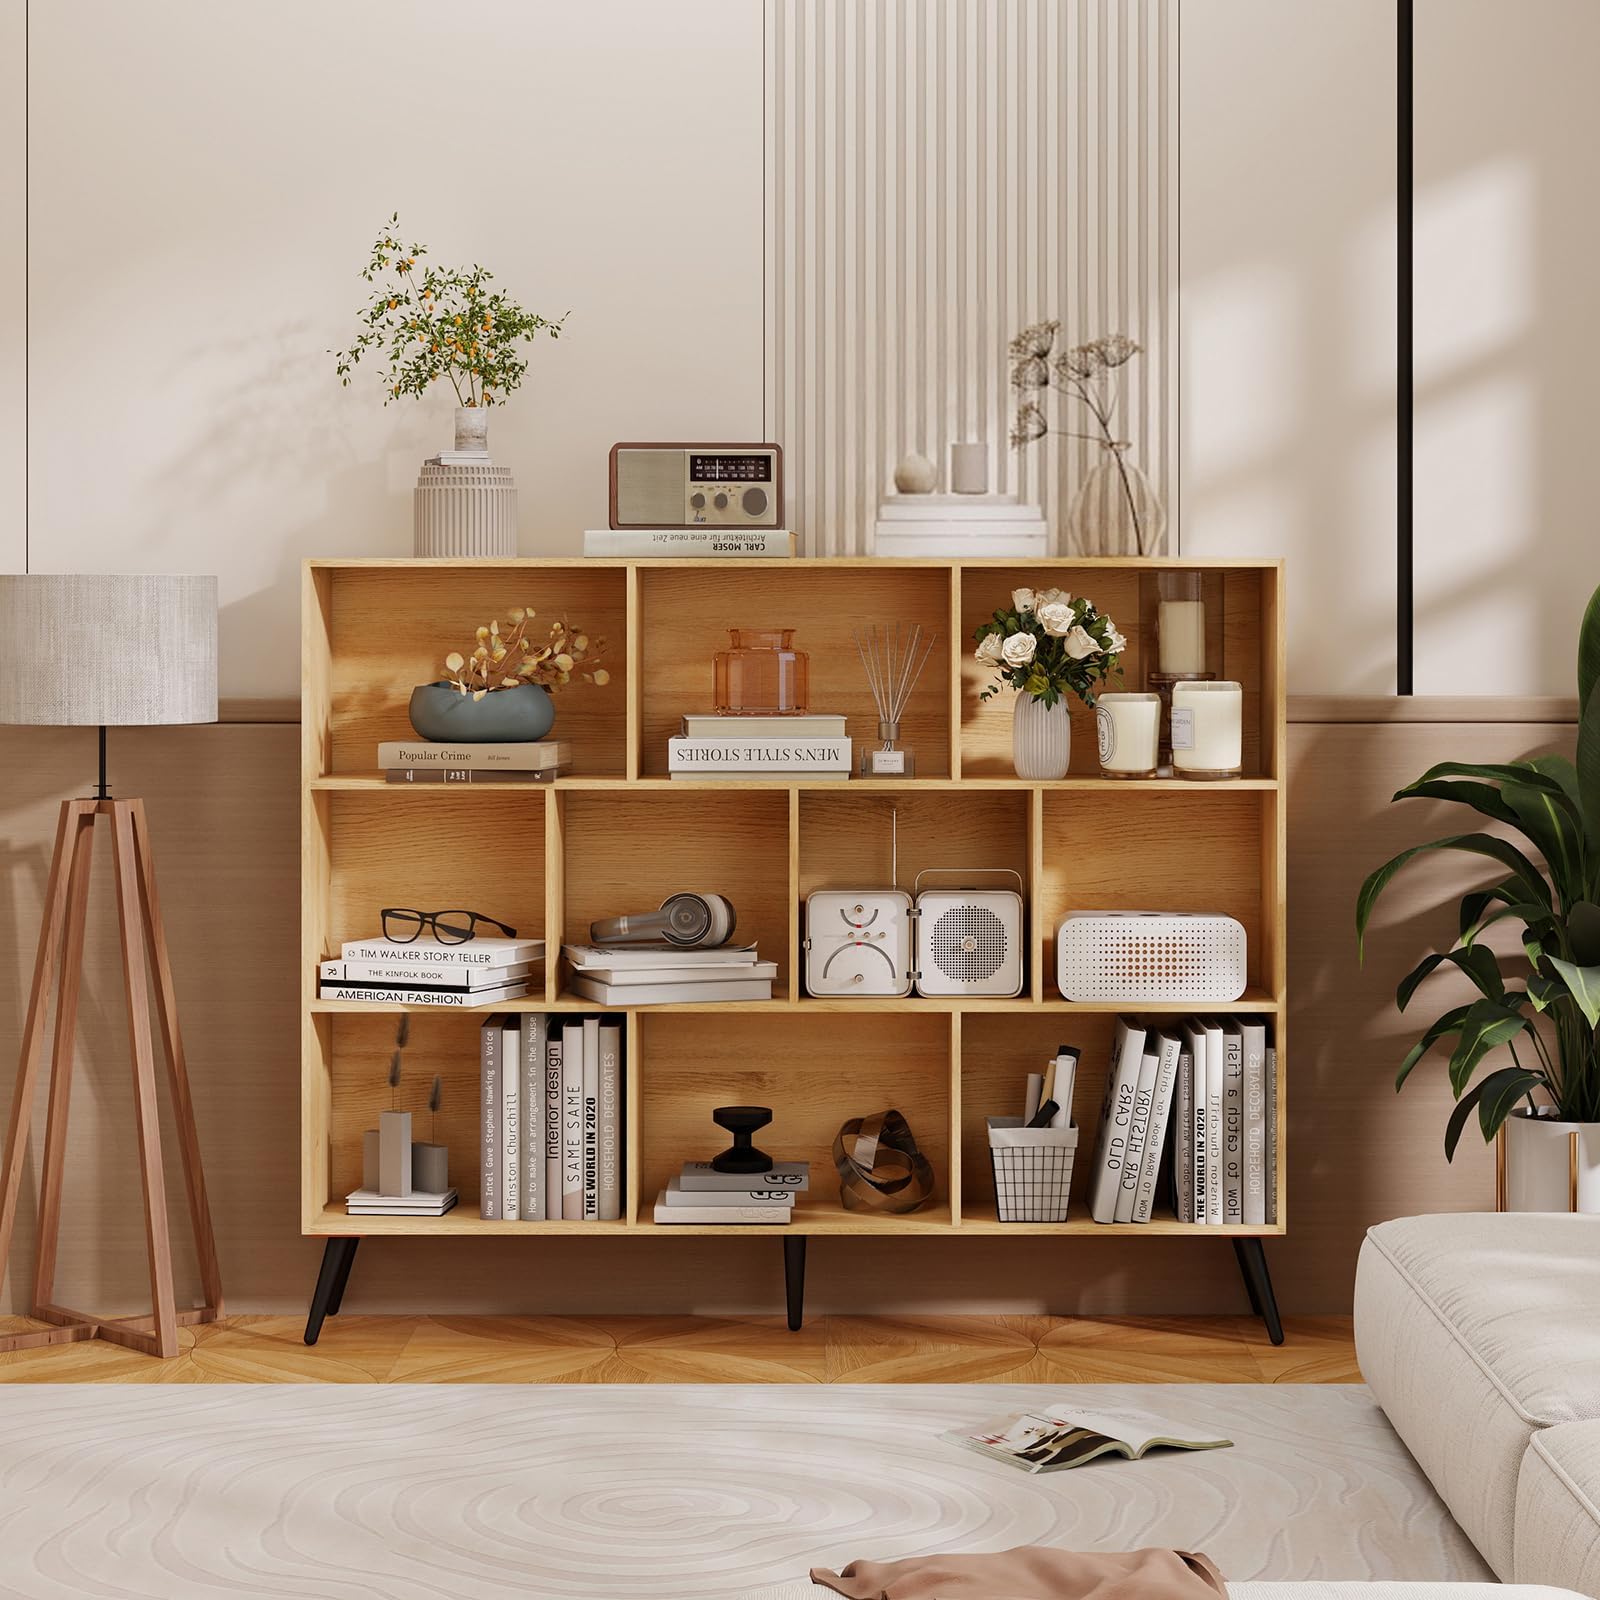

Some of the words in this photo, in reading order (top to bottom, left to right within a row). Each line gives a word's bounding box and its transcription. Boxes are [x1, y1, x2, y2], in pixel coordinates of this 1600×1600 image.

[400, 751, 438, 762] Popular
[441, 751, 471, 760] Crime
[677, 749, 739, 760] STORIES
[744, 749, 790, 760] STYLE
[795, 749, 839, 760] MEN'S
[360, 949, 377, 958] TIM
[380, 950, 420, 960] WALKER
[424, 952, 455, 962] STORY
[459, 954, 490, 962] TELLER
[337, 991, 402, 1001] AMERICAN
[408, 993, 462, 1004] FASHION
[528, 1017, 536, 1042] house
[528, 1048, 536, 1061] the
[528, 1067, 536, 1077] in
[546, 1048, 561, 1099] design
[486, 1070, 494, 1104] Hawking
[604, 1053, 614, 1117] DECORATES
[529, 1083, 538, 1137] arrangement
[567, 1086, 580, 1128] SAME
[586, 1098, 595, 1128] 2020
[486, 1109, 494, 1143] Stephen
[507, 1093, 516, 1154] Churchill
[546, 1105, 559, 1159] Interior
[530, 1143, 536, 1152] an
[586, 1133, 595, 1143] IN
[1197, 1141, 1204, 1152] IN
[528, 1158, 536, 1178] make
[567, 1139, 580, 1182] SAME
[586, 1148, 595, 1190] WORLD
[604, 1126, 614, 1190] HOUSEHOLD
[507, 1163, 516, 1211] Winston
[529, 1183, 536, 1192] to
[528, 1198, 536, 1212] How
[586, 1193, 595, 1215] THE
